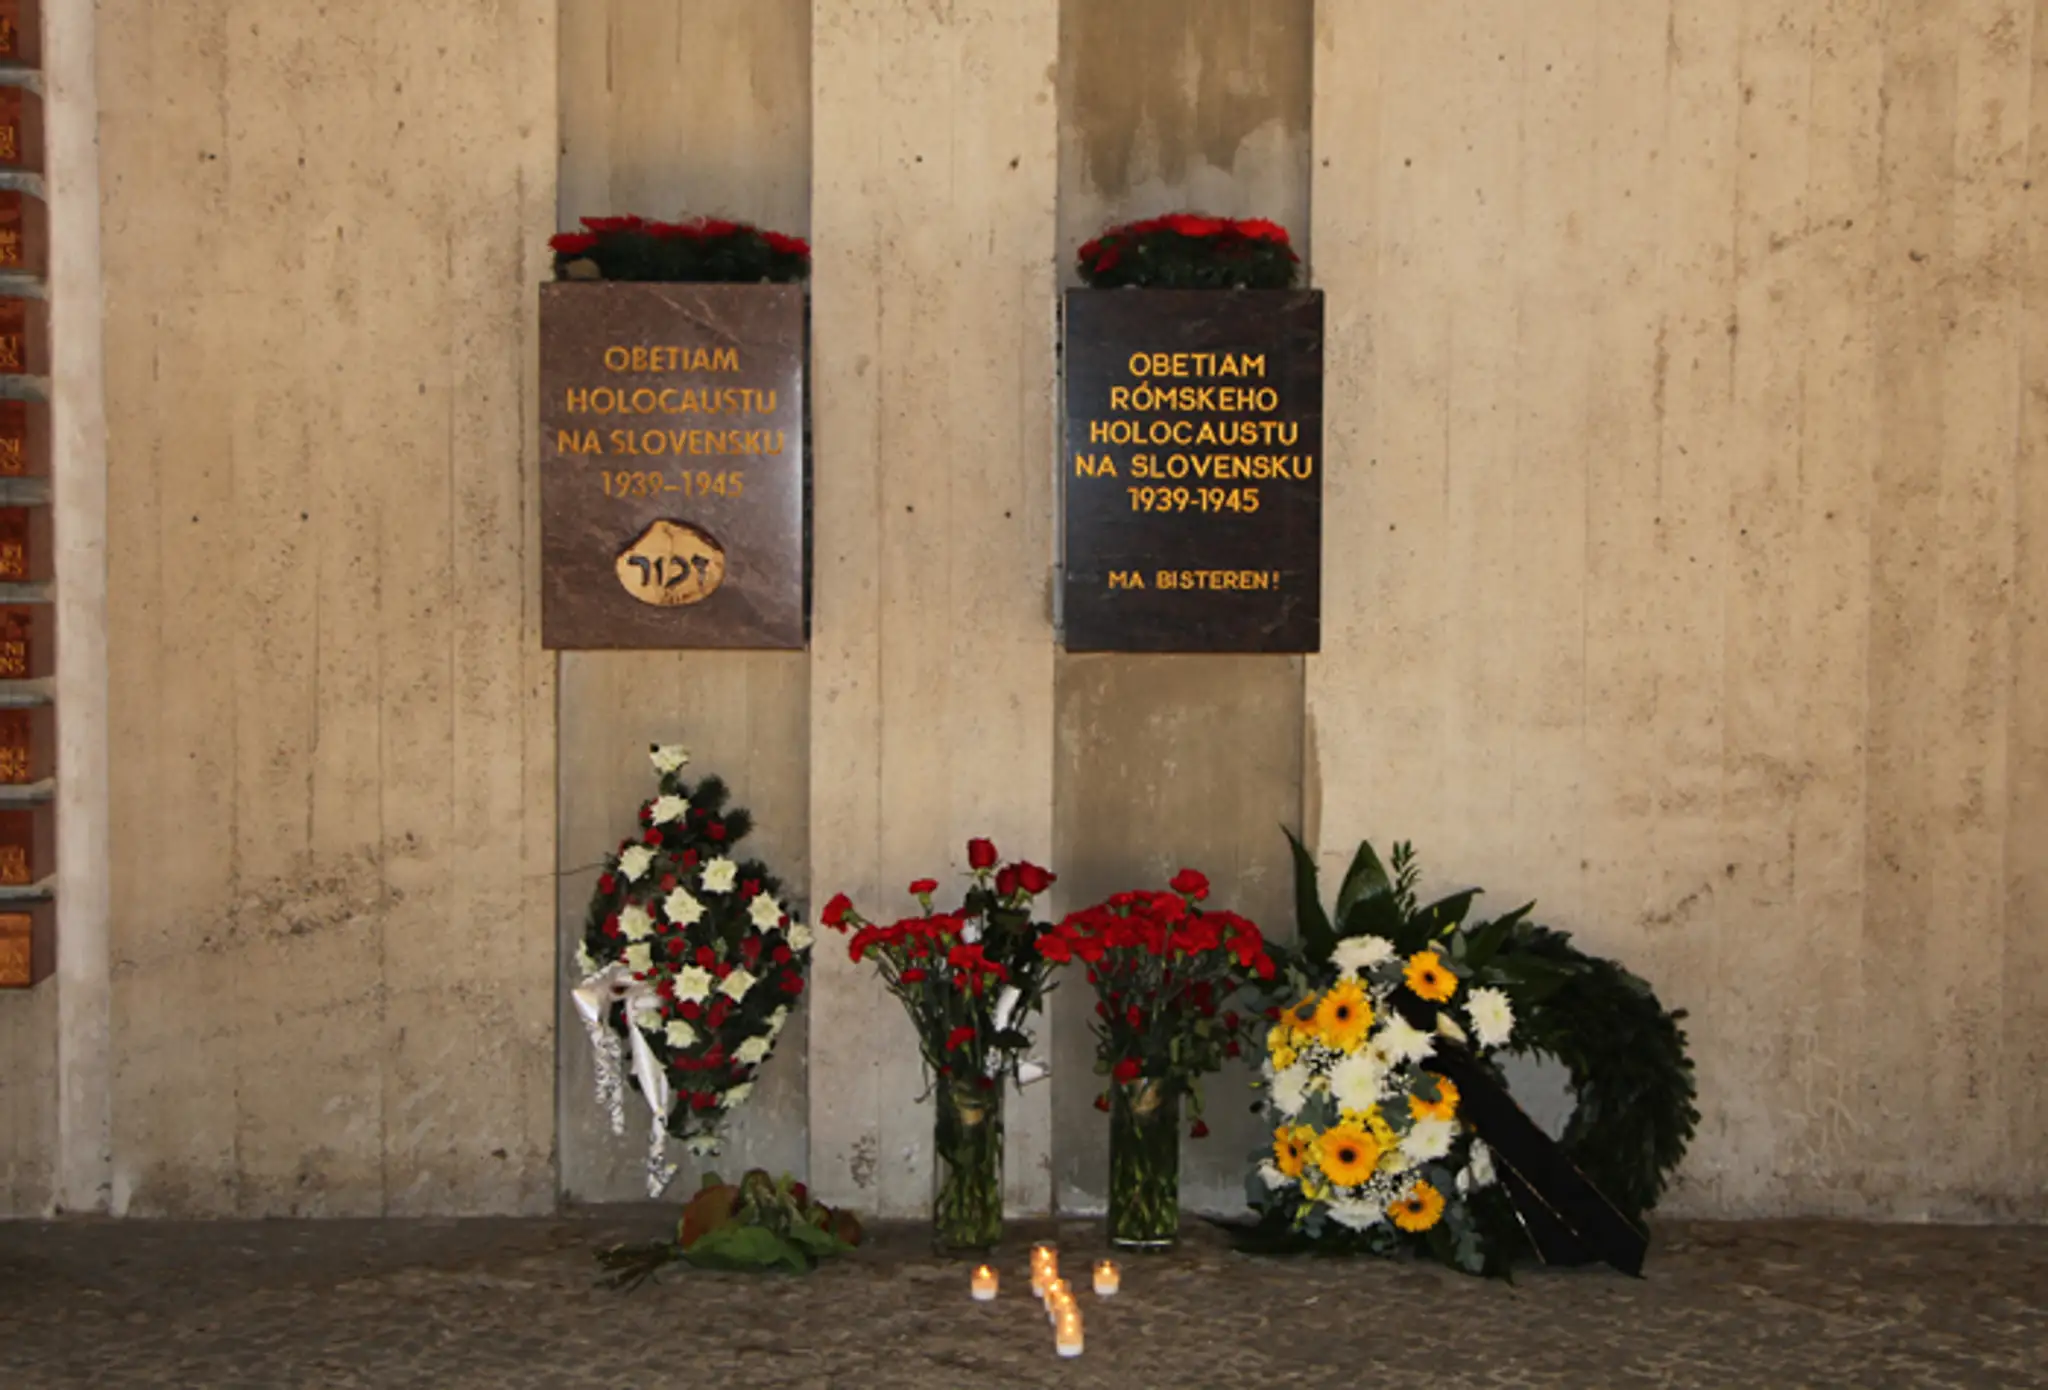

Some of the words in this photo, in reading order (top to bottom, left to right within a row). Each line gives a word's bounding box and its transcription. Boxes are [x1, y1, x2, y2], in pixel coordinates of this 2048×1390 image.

[604, 345, 740, 372] OBETIAM
[1128, 351, 1267, 378] OBETIAM
[565, 387, 777, 415] HOLOCAUSTU
[1110, 380, 1279, 412] RÓMSKEHO
[556, 429, 604, 456] NA
[608, 428, 785, 456] SLOVENSKU
[1089, 420, 1299, 446] HOLOCAUSTU
[1074, 453, 1118, 479] NA
[1130, 453, 1314, 480] SLOVENSKU
[1126, 487, 1260, 513] 1939-1945
[1107, 570, 1146, 591] MA
[1155, 570, 1281, 591] BISTEREN!
